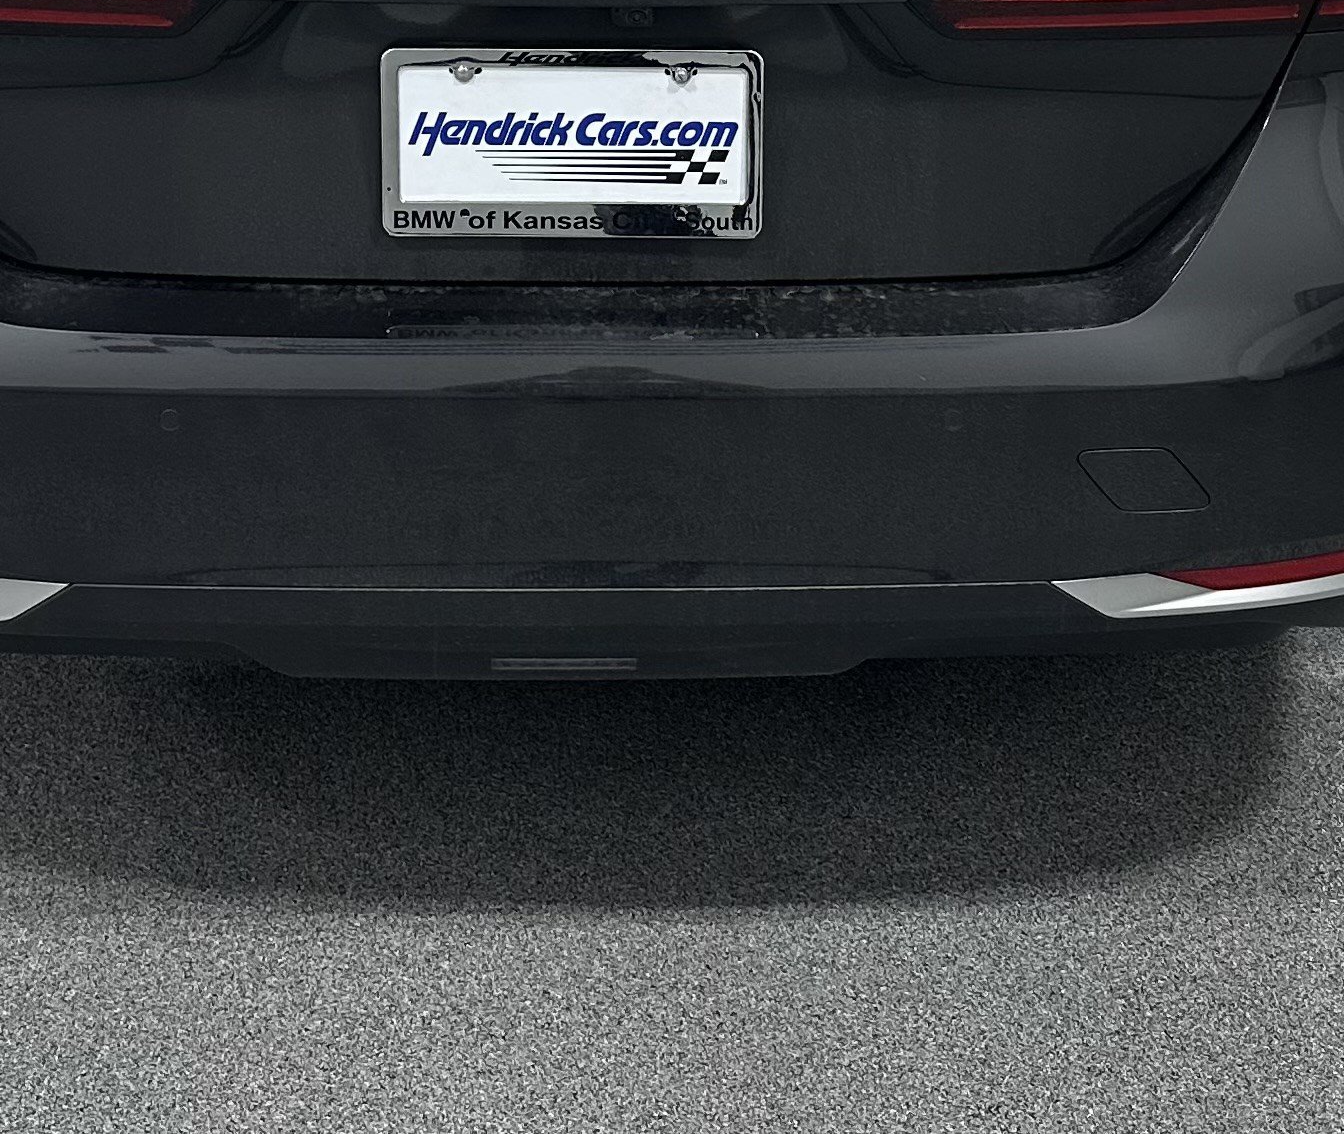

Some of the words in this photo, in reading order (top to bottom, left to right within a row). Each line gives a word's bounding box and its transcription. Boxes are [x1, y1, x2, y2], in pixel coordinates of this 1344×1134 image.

[393, 210, 455, 229] BMW
[468, 210, 496, 230] of
[503, 210, 604, 231] Kansas
[688, 209, 754, 231] South
